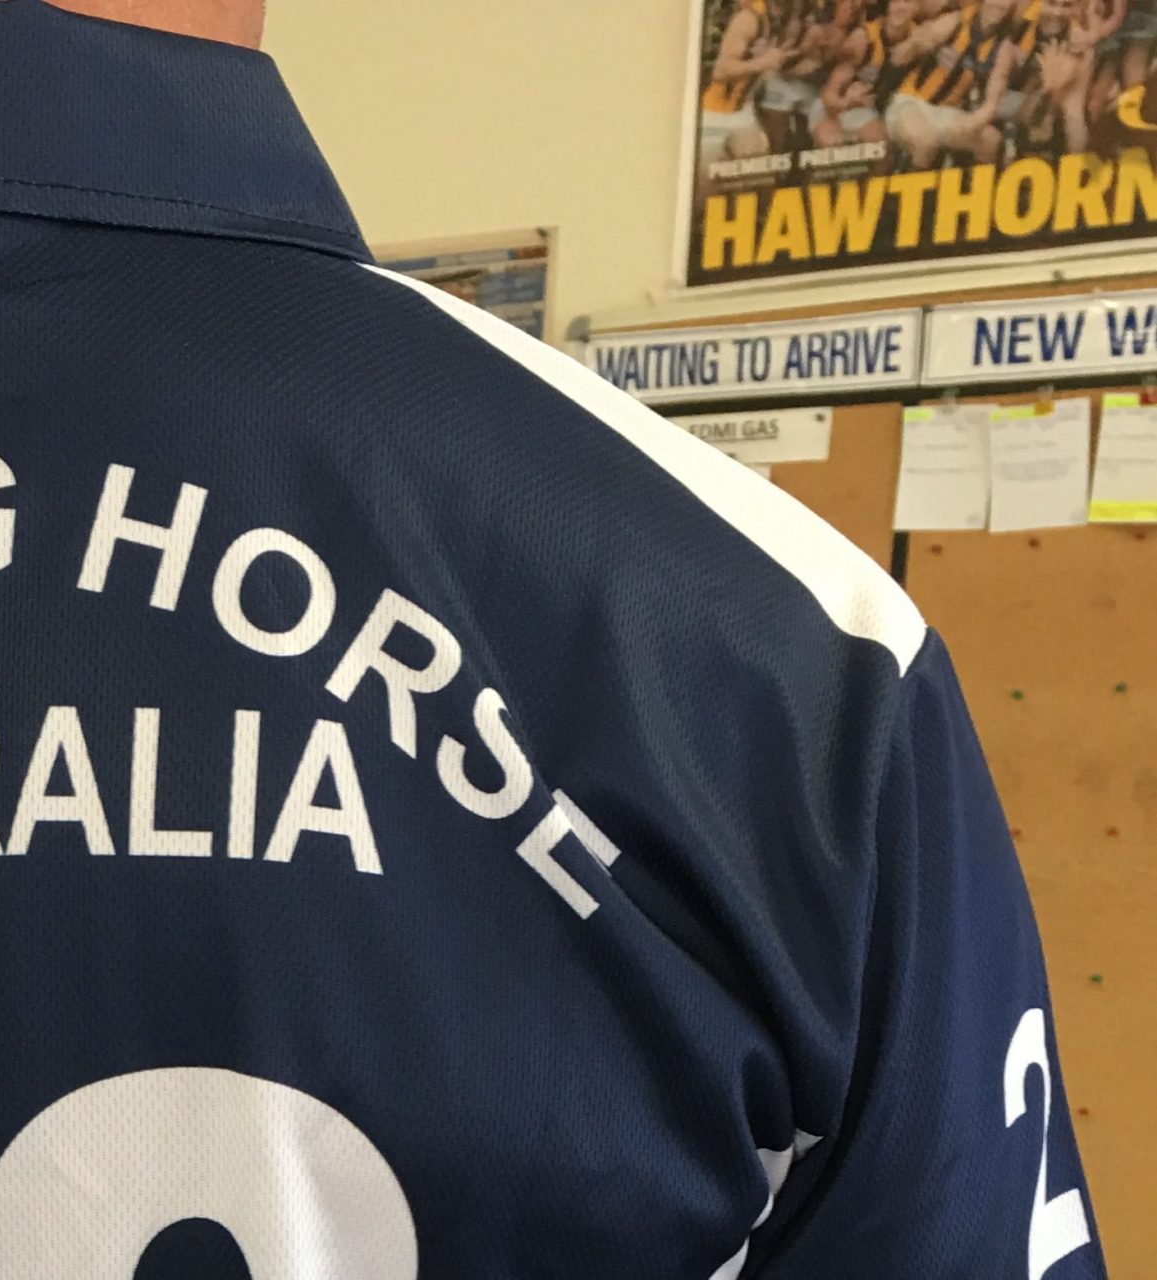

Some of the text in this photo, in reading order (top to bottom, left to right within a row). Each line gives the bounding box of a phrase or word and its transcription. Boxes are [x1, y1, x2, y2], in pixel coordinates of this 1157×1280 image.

[701, 147, 1157, 271] HAWTHORN
[595, 325, 904, 391] WAITING TO ARRIVE
[972, 304, 1157, 367] NEW W
[742, 418, 780, 437] GAS
[76, 462, 622, 921] HORSE
